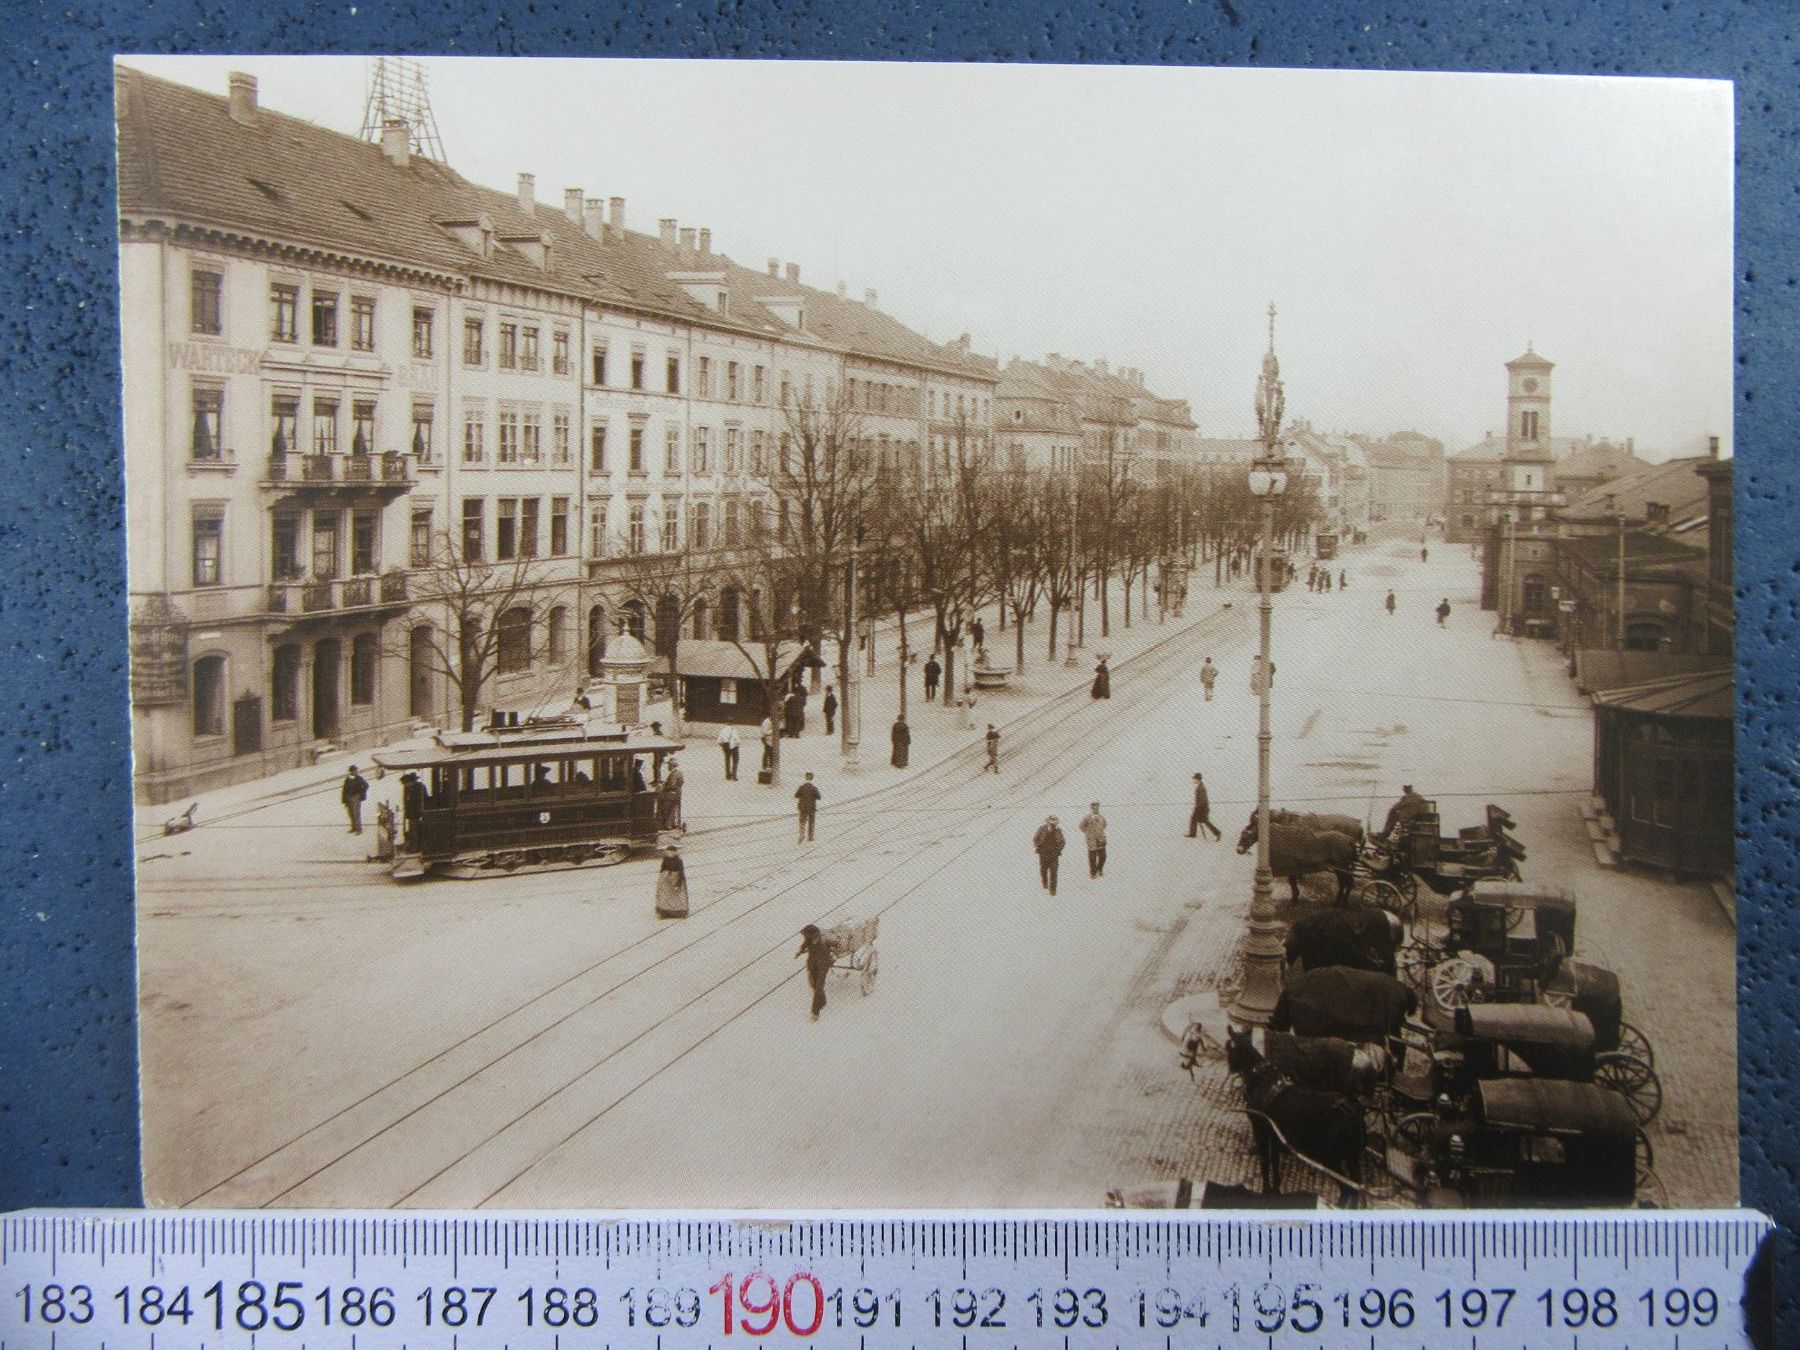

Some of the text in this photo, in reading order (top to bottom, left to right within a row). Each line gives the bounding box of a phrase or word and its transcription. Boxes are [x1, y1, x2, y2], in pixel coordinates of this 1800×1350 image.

[16, 1271, 1718, 1336] 183 184 185 186 187 188 189 190 191 192 193 194 195 196 197 198 199
